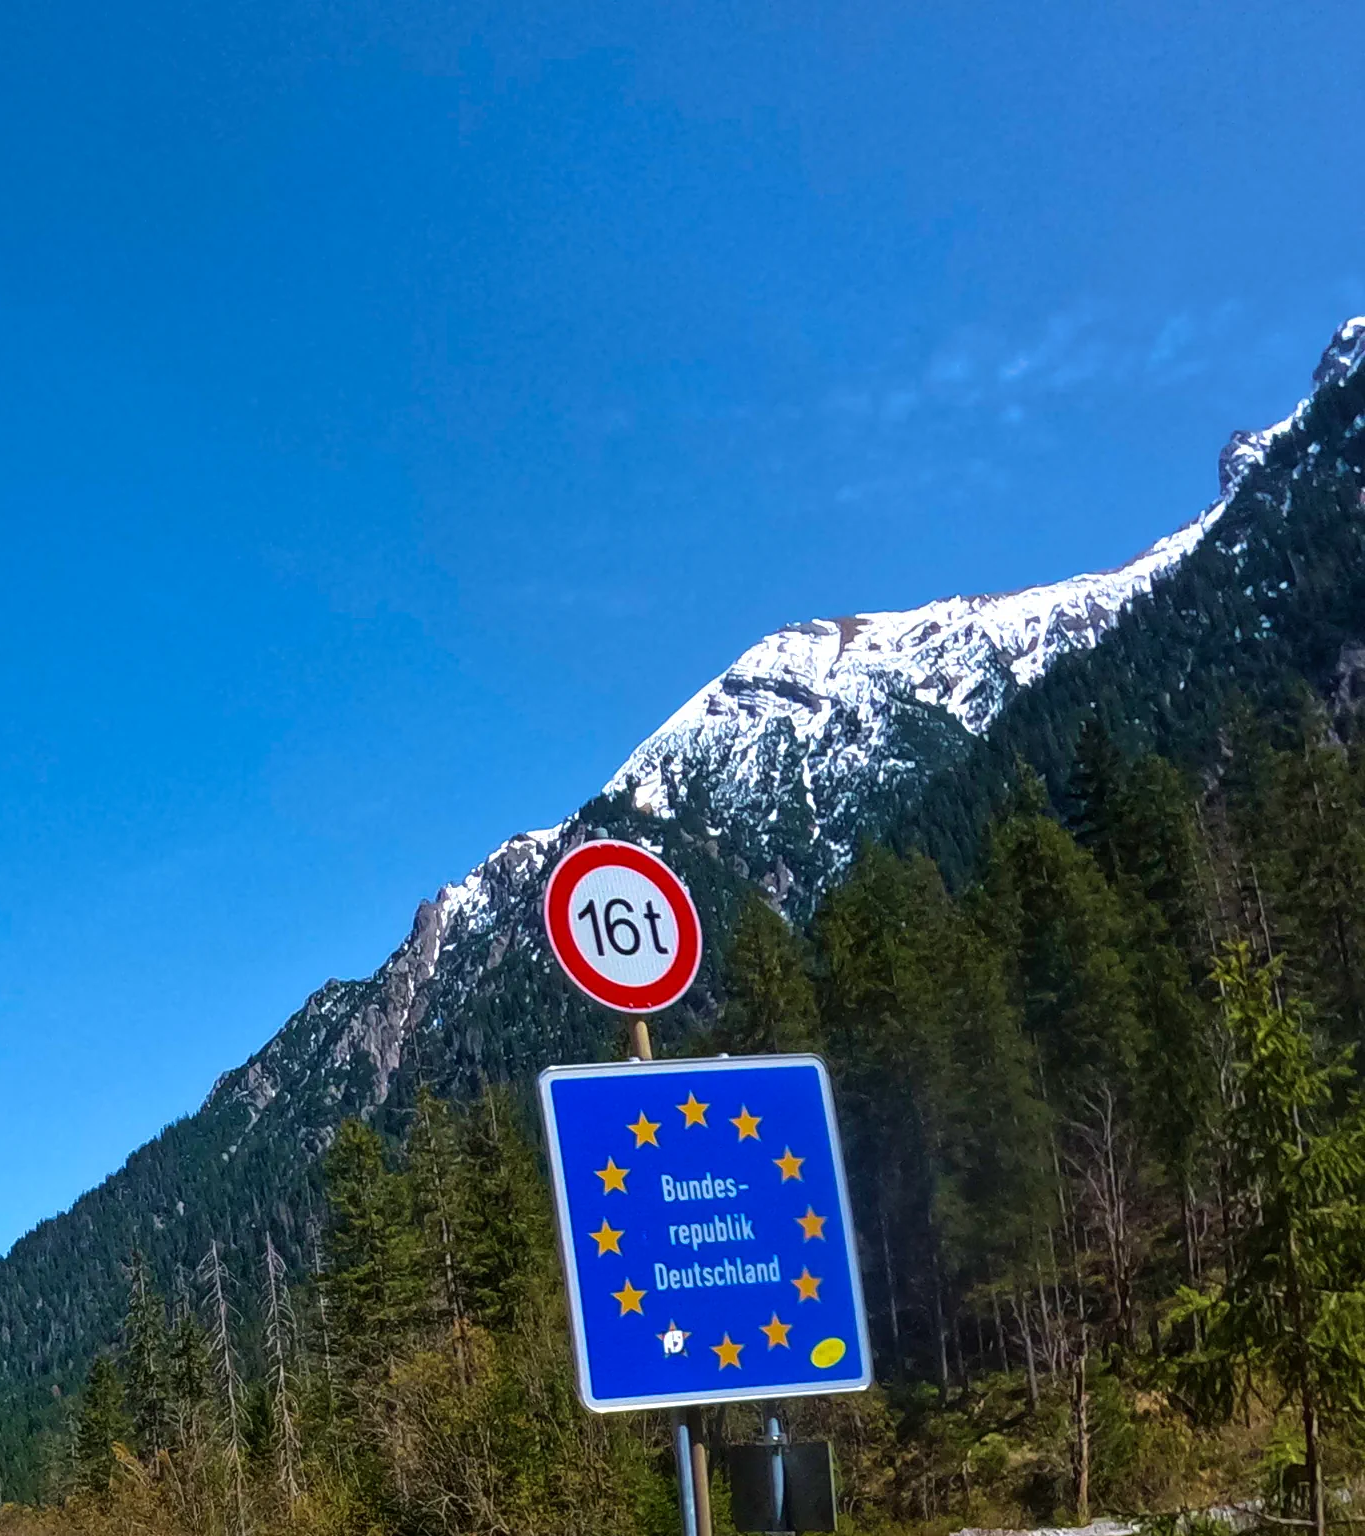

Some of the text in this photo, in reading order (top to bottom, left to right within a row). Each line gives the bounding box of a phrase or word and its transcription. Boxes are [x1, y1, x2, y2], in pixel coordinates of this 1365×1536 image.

[660, 1171, 749, 1202] Bundes-
[669, 1213, 756, 1251] republik
[654, 1253, 782, 1291] Deutschland
